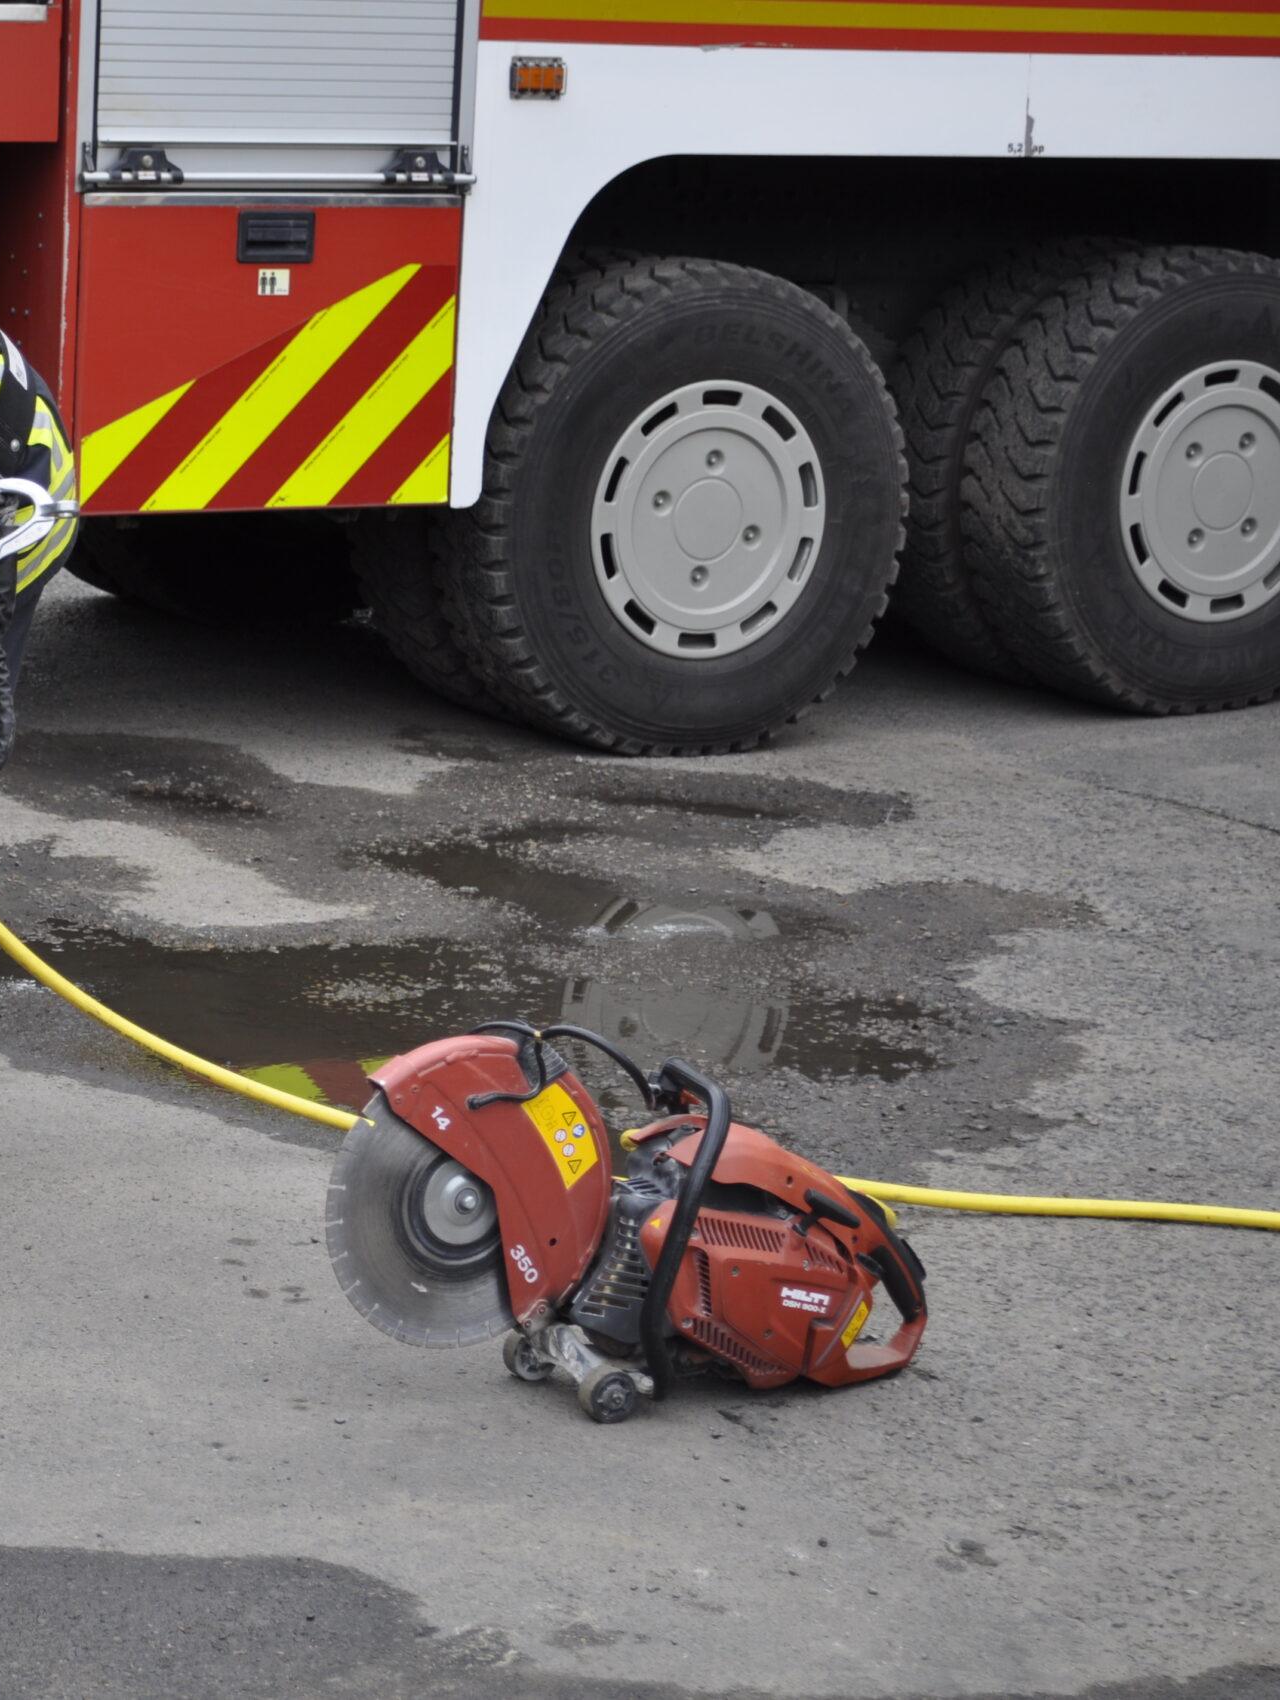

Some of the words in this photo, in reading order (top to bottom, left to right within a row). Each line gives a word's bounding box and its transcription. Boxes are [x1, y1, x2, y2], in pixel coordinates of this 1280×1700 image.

[431, 1105, 452, 1131] 14
[509, 1244, 539, 1284] 350
[781, 1287, 830, 1306] HILTI
